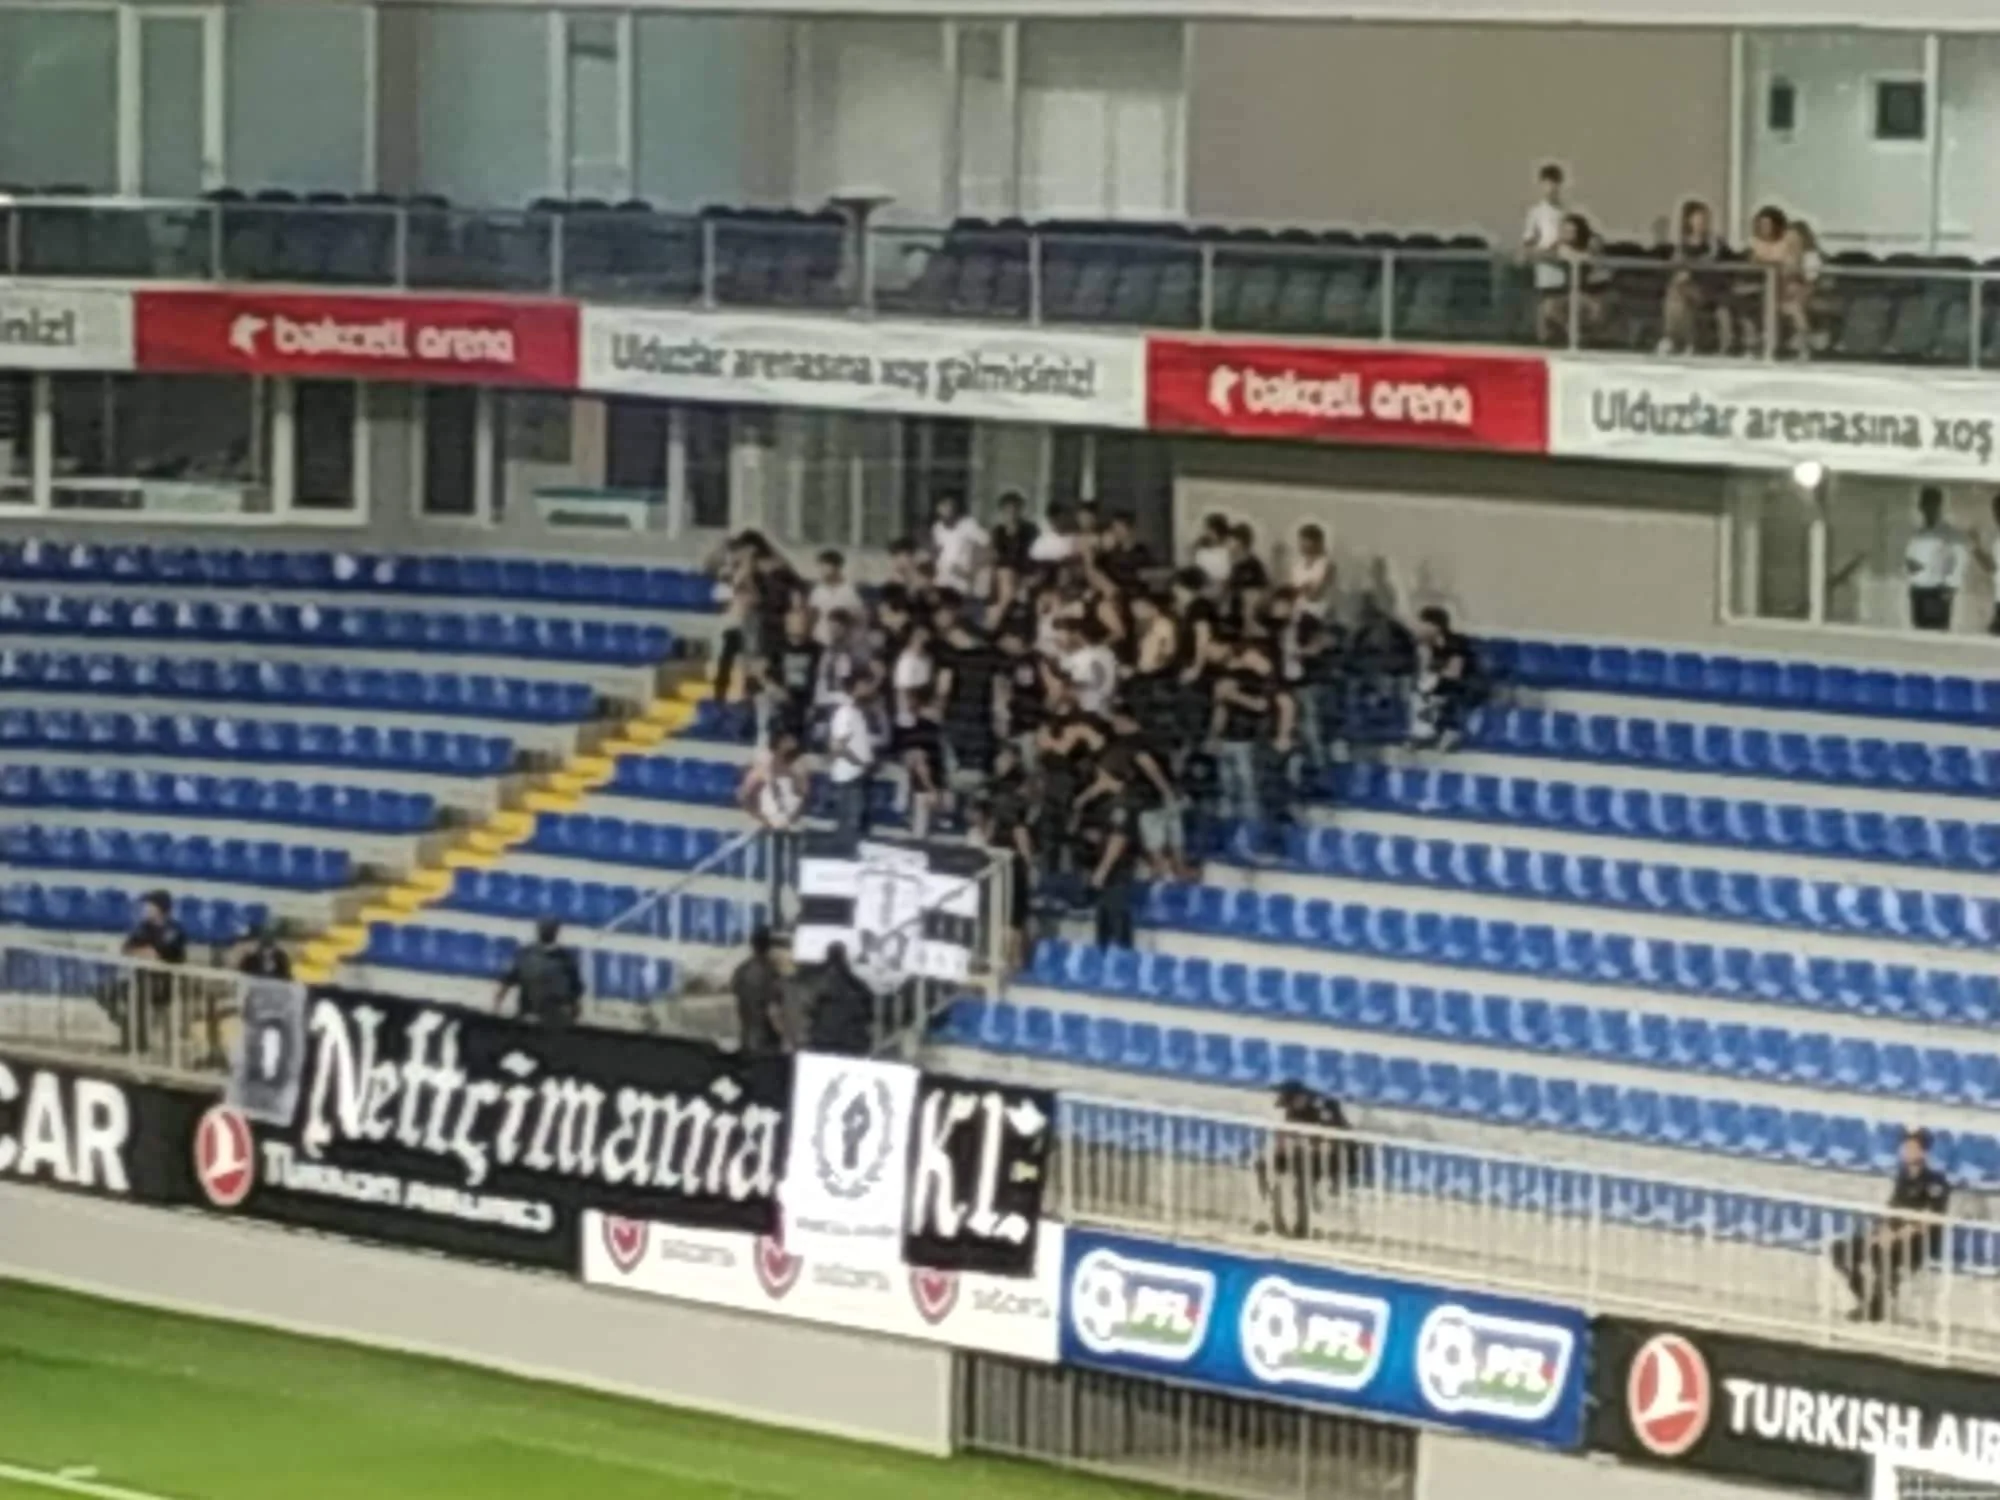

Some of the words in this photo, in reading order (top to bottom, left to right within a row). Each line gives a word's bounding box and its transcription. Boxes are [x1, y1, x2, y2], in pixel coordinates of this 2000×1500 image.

[1369, 380, 1473, 427] arena
[1591, 387, 1738, 438] Ulduzlar
[1931, 416, 1994, 466] xoş
[1722, 1378, 1922, 1458] TURKISH
